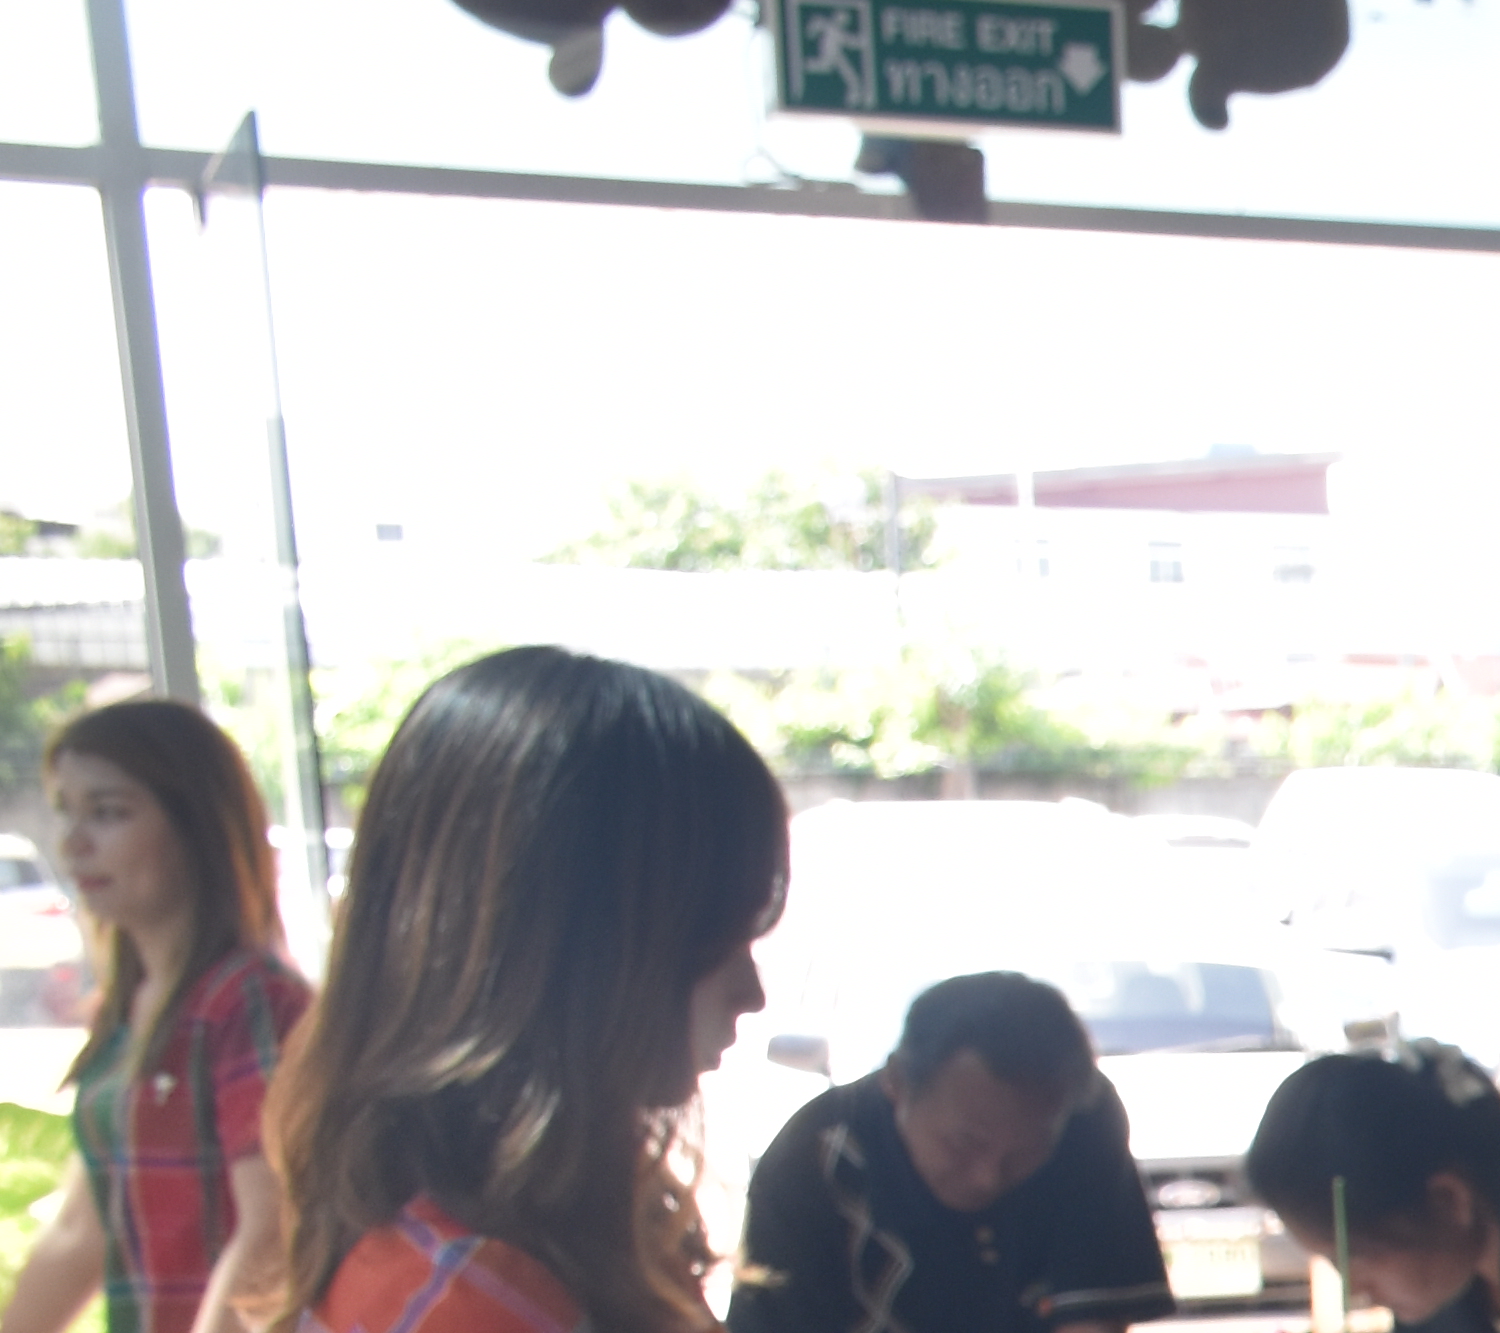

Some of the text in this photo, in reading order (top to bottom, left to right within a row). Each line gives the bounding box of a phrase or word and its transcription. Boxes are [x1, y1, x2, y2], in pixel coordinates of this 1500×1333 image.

[881, 7, 1057, 55] FIRE EXIT
[884, 60, 1067, 116] ทางออก
